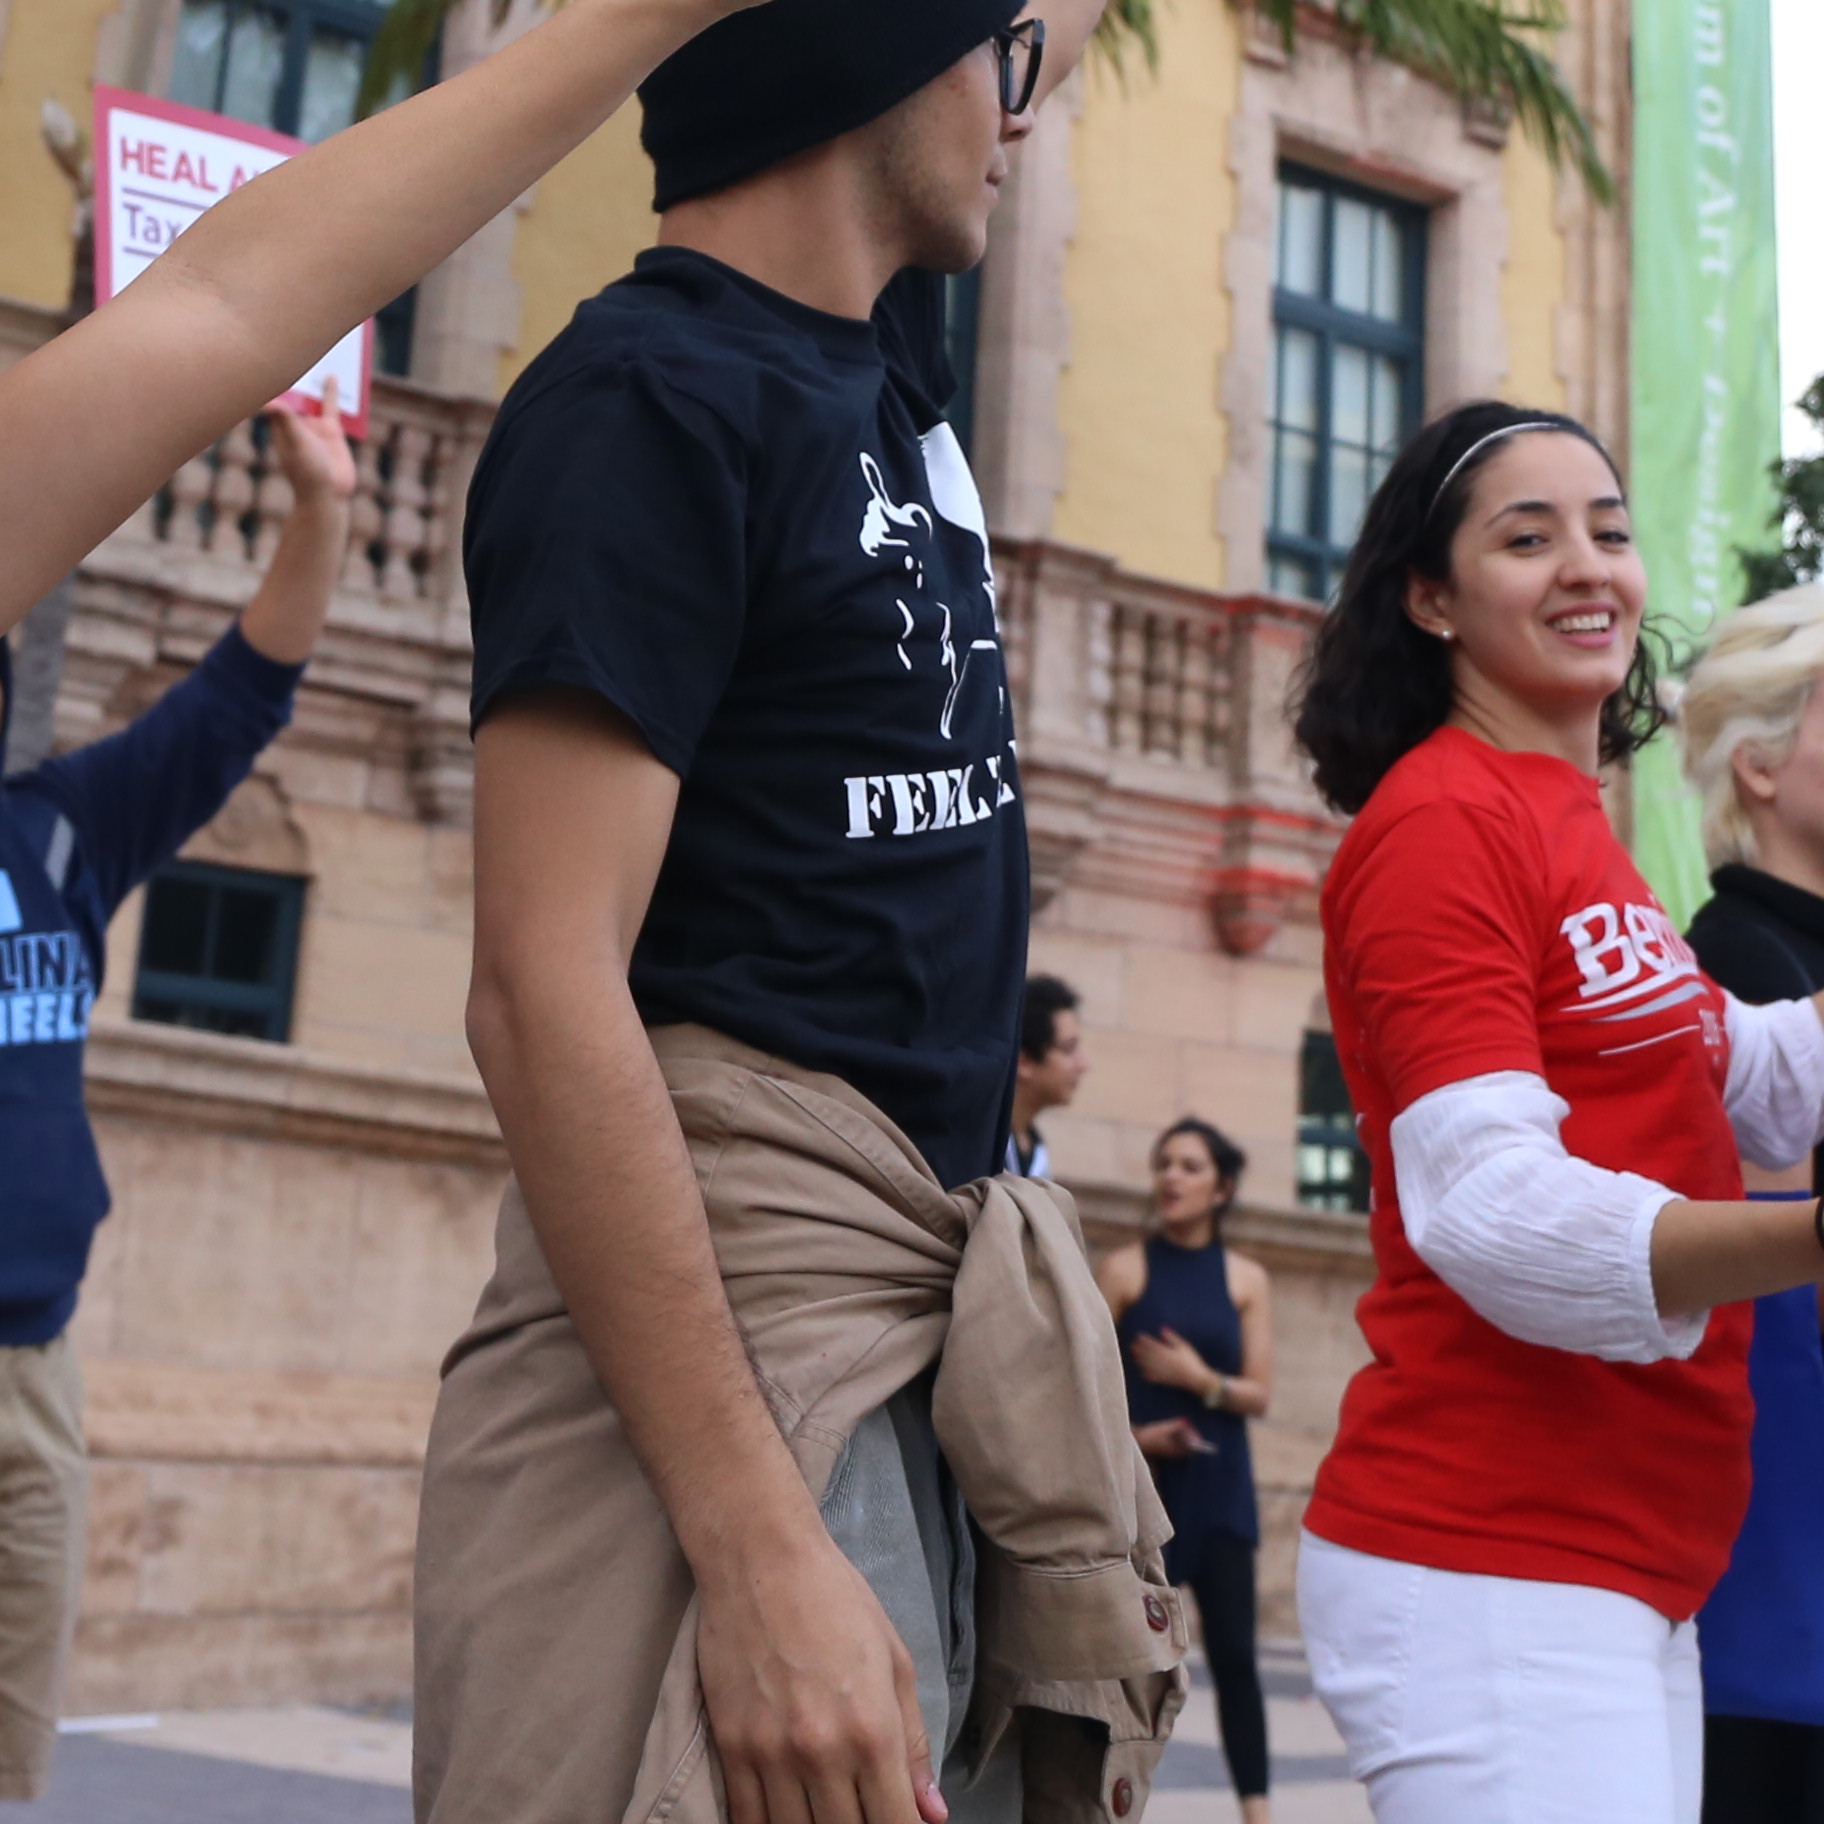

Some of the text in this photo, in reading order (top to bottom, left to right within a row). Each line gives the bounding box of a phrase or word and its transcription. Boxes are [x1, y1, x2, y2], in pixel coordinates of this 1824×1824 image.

[1695, 84, 1739, 164] of
[119, 135, 218, 194] HEAL
[1695, 172, 1738, 275] Art
